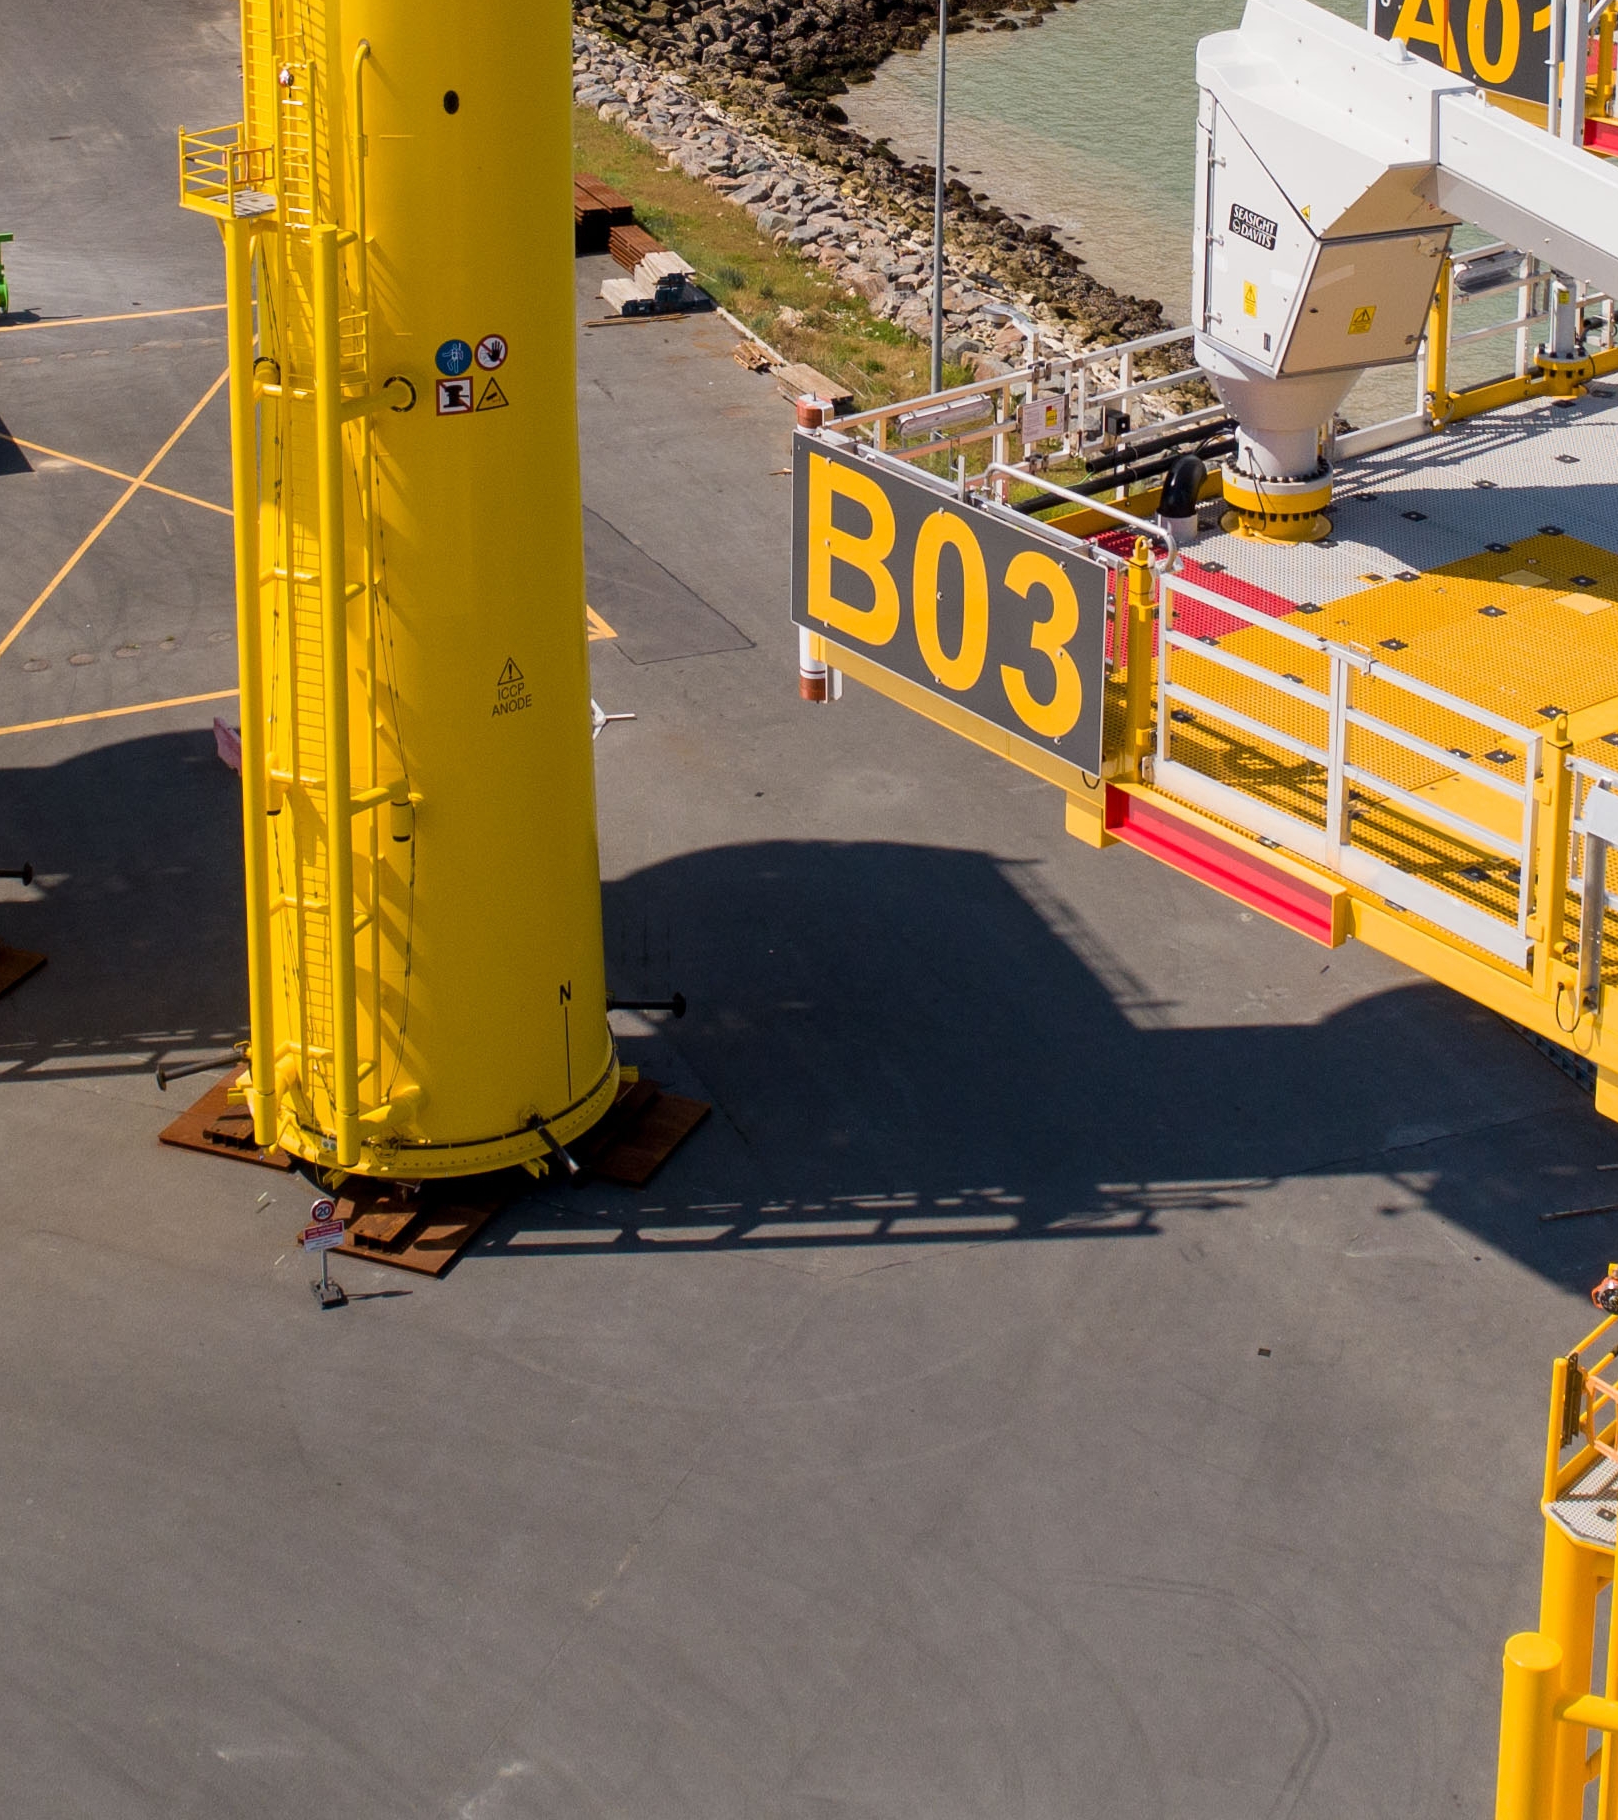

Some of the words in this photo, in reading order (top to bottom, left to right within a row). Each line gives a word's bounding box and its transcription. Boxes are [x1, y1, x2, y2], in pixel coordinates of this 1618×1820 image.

[1233, 206, 1276, 235] SEASIGHT
[1240, 224, 1272, 248] DAVITS
[808, 452, 1083, 738] B03
[498, 682, 525, 700] ICCP
[492, 694, 532, 717] ANODE
[559, 980, 572, 1006] N
[316, 1206, 331, 1218] 20
